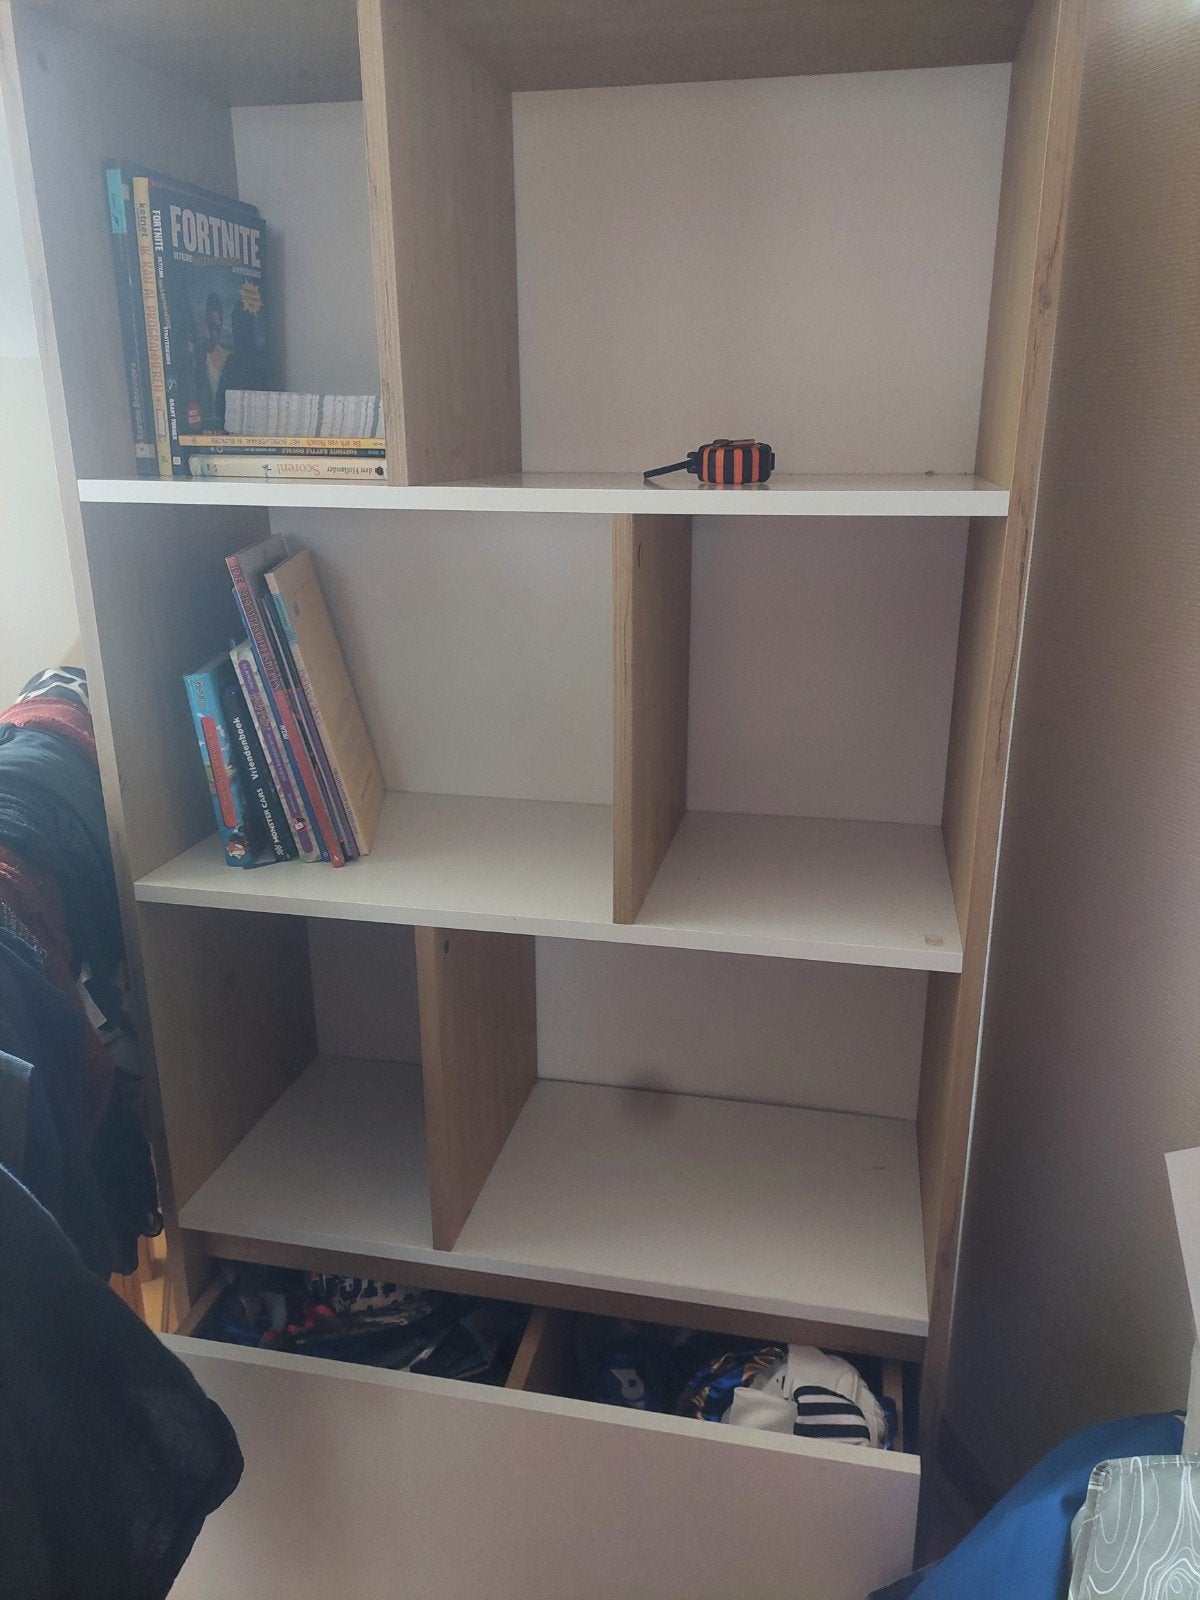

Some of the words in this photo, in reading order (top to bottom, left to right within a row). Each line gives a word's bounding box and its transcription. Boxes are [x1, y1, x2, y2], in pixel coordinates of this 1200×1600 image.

[152, 210, 163, 252] FORTNITE
[169, 203, 261, 268] FORTNITE
[142, 262, 154, 283] KAN
[306, 439, 326, 447] Noach
[276, 463, 320, 476] Scoren!
[326, 466, 359, 475] Hollander
[361, 466, 373, 475] den
[256, 787, 270, 809] CARS
[263, 809, 280, 843] MONSTER
